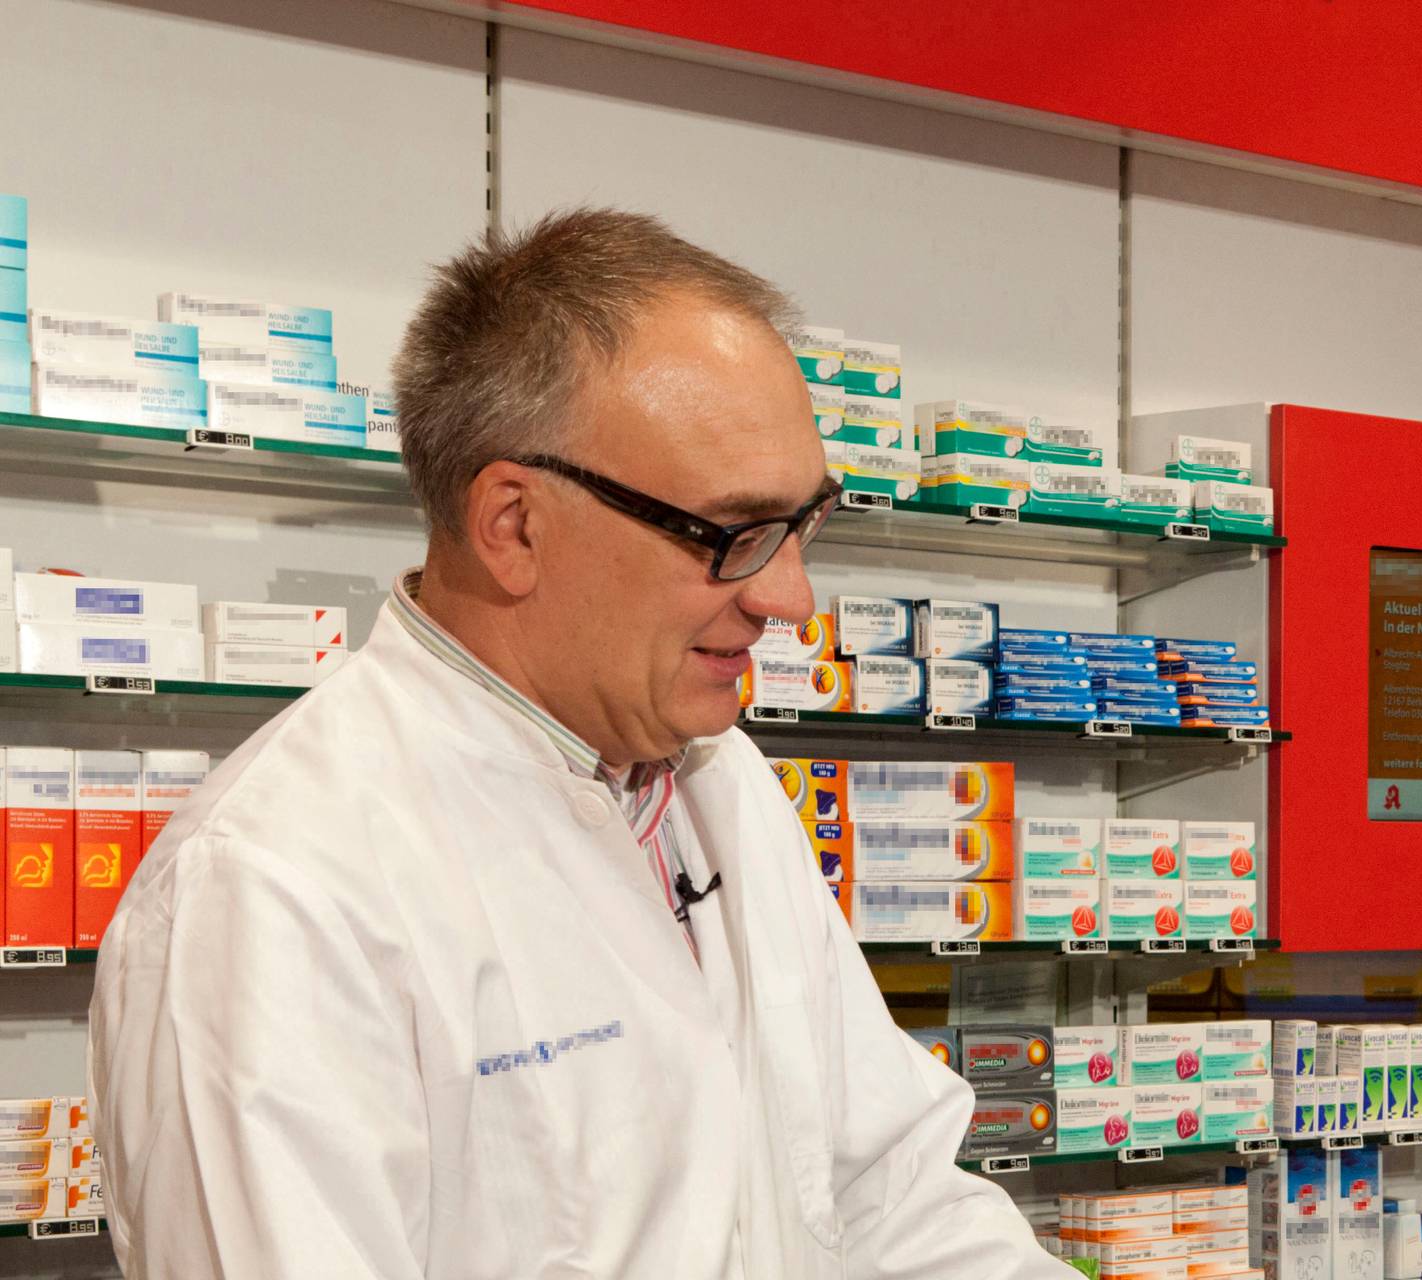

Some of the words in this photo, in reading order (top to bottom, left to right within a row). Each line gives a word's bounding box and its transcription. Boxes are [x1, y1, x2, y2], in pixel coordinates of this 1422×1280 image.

[1384, 622, 1395, 633] in
[1396, 622, 1415, 634] der
[1383, 759, 1414, 769] weitere
[7, 951, 18, 963] €
[975, 1058, 1006, 1067] IMMEDIA
[977, 1125, 1009, 1133] IMMEDIA
[40, 1223, 51, 1235] €
